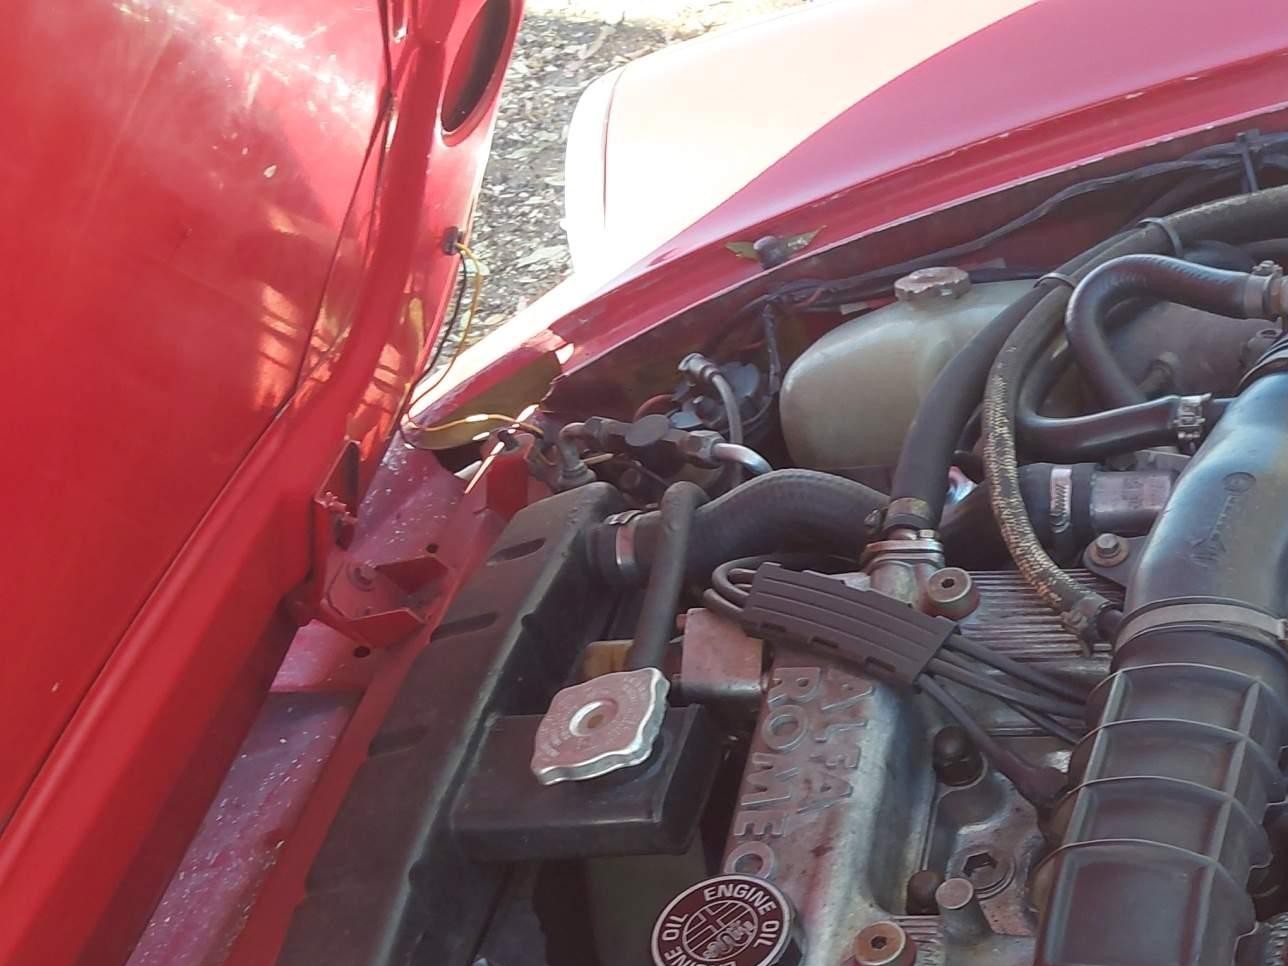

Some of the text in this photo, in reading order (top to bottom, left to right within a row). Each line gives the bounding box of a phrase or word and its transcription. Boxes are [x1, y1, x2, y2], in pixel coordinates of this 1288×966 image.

[797, 667, 876, 815] ALFA
[661, 912, 689, 942] OIL
[703, 883, 780, 949] ENGINE OIL
